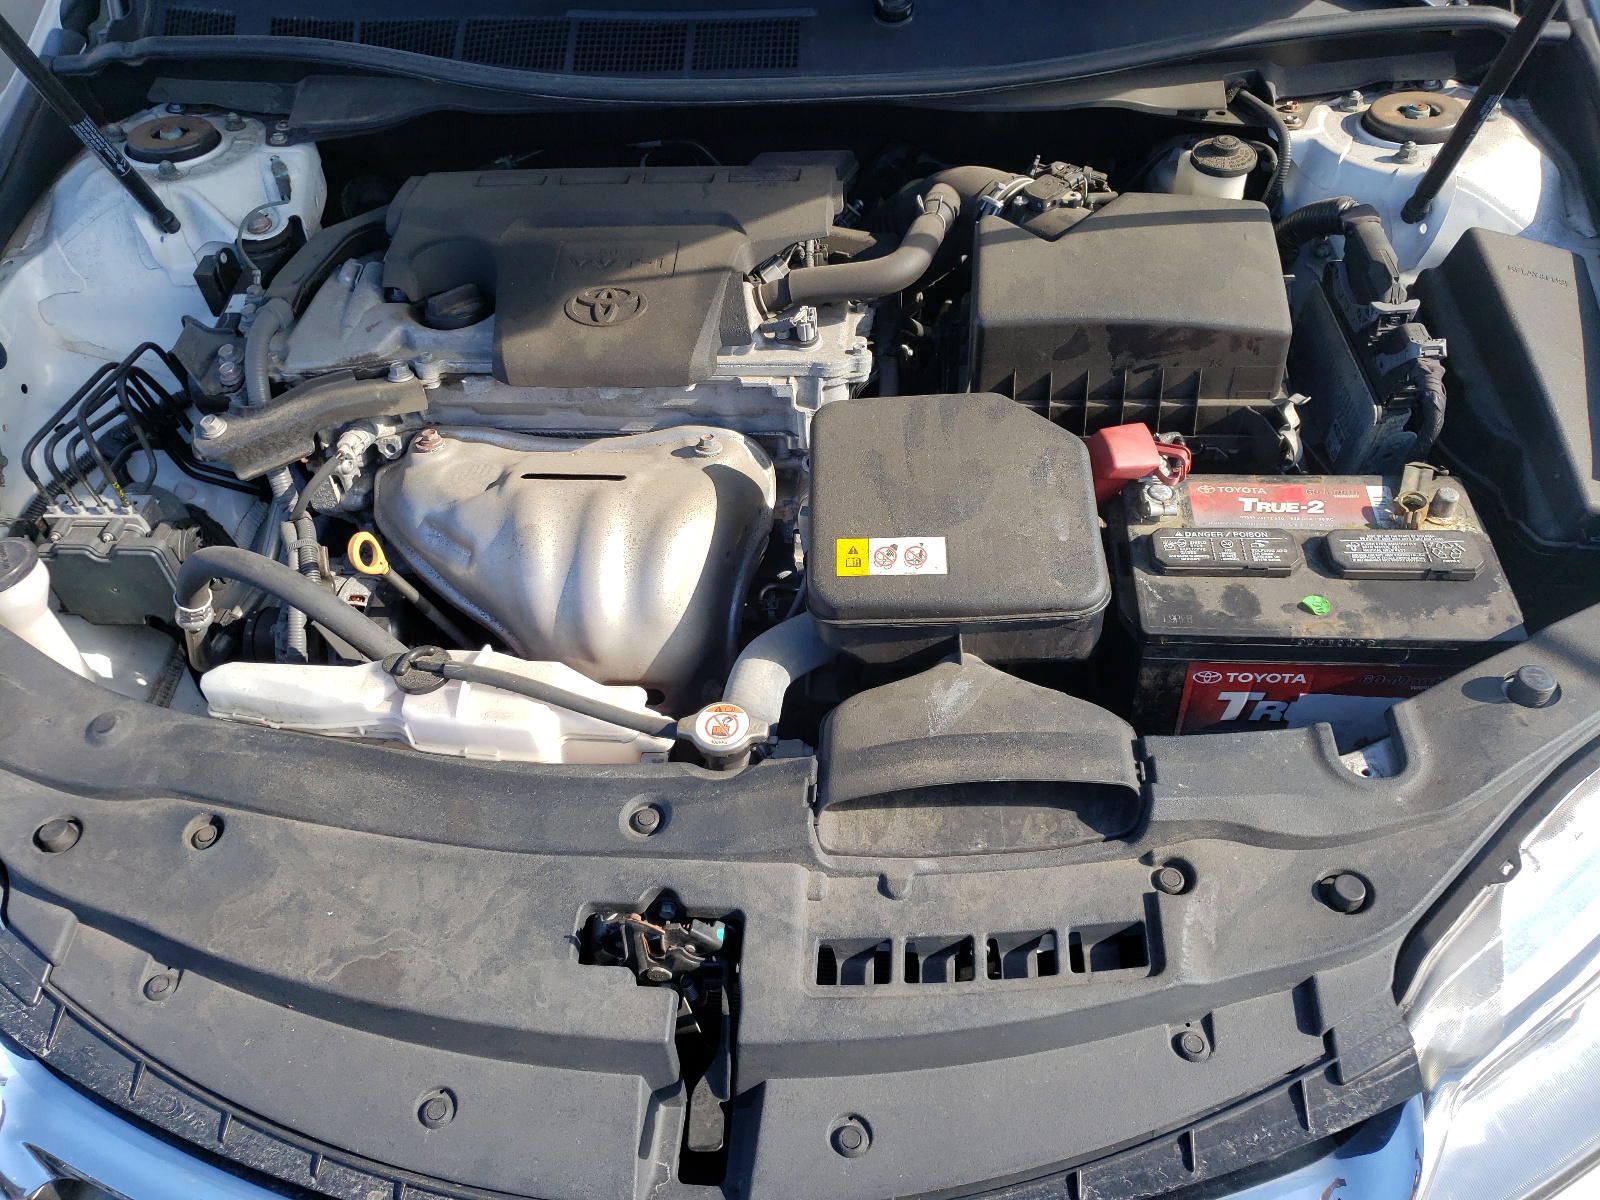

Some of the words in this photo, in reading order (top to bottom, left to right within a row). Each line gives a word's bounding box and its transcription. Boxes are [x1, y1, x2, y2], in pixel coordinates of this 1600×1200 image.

[1217, 486, 1268, 495] TOYOTA
[1238, 497, 1325, 514] TRUE-2
[1226, 672, 1307, 684] TOYOTA
[1217, 691, 1289, 722] TR
